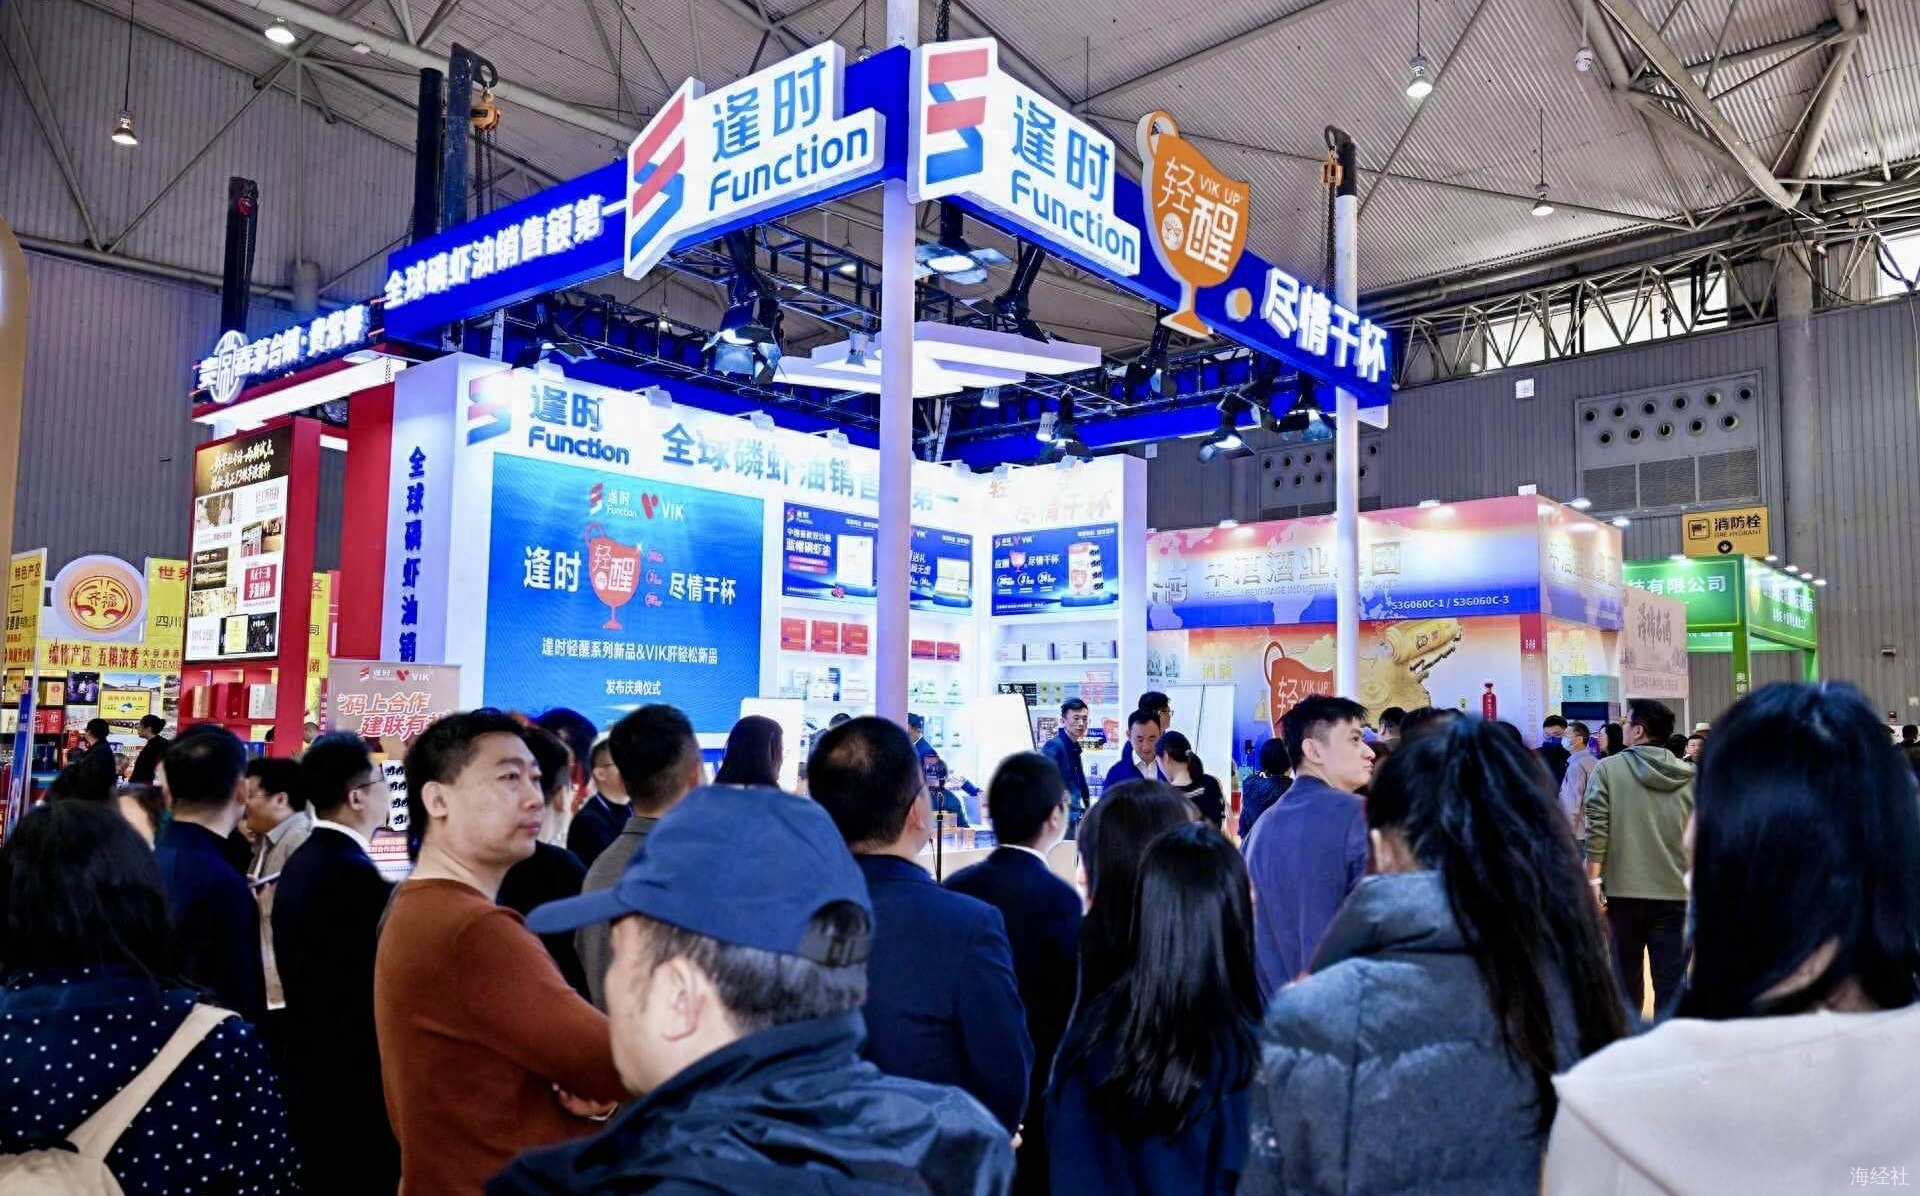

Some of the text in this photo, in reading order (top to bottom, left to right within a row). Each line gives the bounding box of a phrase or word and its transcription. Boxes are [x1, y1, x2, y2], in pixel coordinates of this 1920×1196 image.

[713, 56, 826, 163] 逢时
[1012, 95, 1109, 201] 逢时
[709, 128, 867, 211] Function
[1200, 175, 1241, 205] VIK UP
[1011, 169, 1135, 264] Function
[1263, 267, 1387, 382] 尽情干杯
[530, 384, 604, 432] 逢时
[528, 425, 631, 466] Function
[662, 502, 685, 521] VIK
[1714, 514, 1761, 531] 消防栓
[523, 545, 582, 593] 逢时
[668, 572, 737, 605] 尽情干杯
[1392, 599, 1444, 610] S3G060C-1
[1453, 595, 1510, 607] S3G060C-3
[542, 637, 718, 665] 逢时轻醒系列新品&VIK肝轻松新品
[343, 691, 431, 715] 码上合作
[605, 679, 663, 696] 发布庆典仪式
